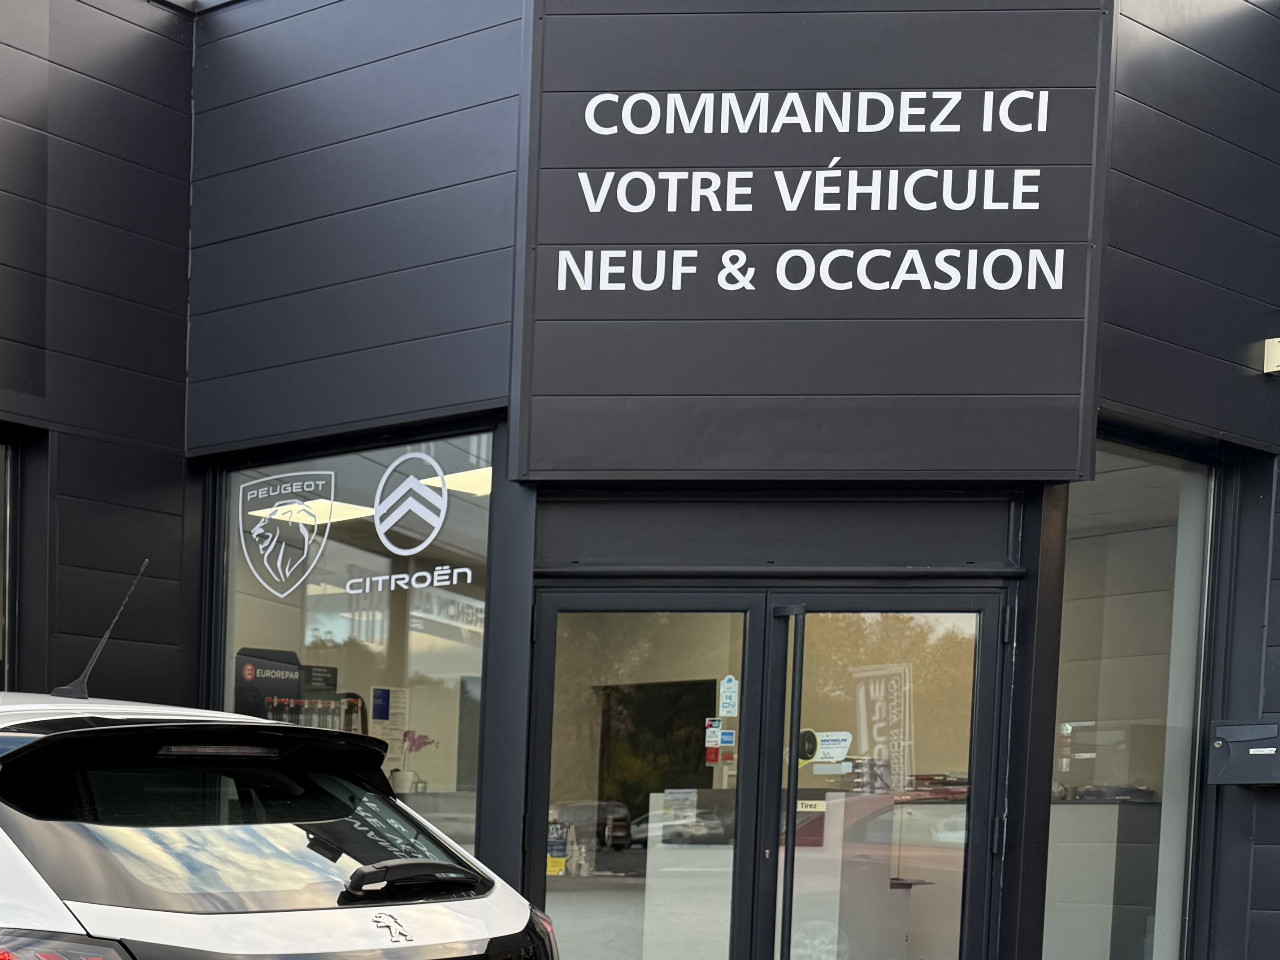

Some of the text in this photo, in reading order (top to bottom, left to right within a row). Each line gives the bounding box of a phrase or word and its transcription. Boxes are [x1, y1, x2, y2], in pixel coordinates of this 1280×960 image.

[583, 90, 1049, 135] COMMANDEZ ICI
[578, 157, 1041, 213] VOTRE VÉHICULE
[557, 248, 1065, 291] NEUF & OCCASION
[247, 480, 326, 501] PEUGEOT
[256, 668, 300, 680] EUROREPAR
